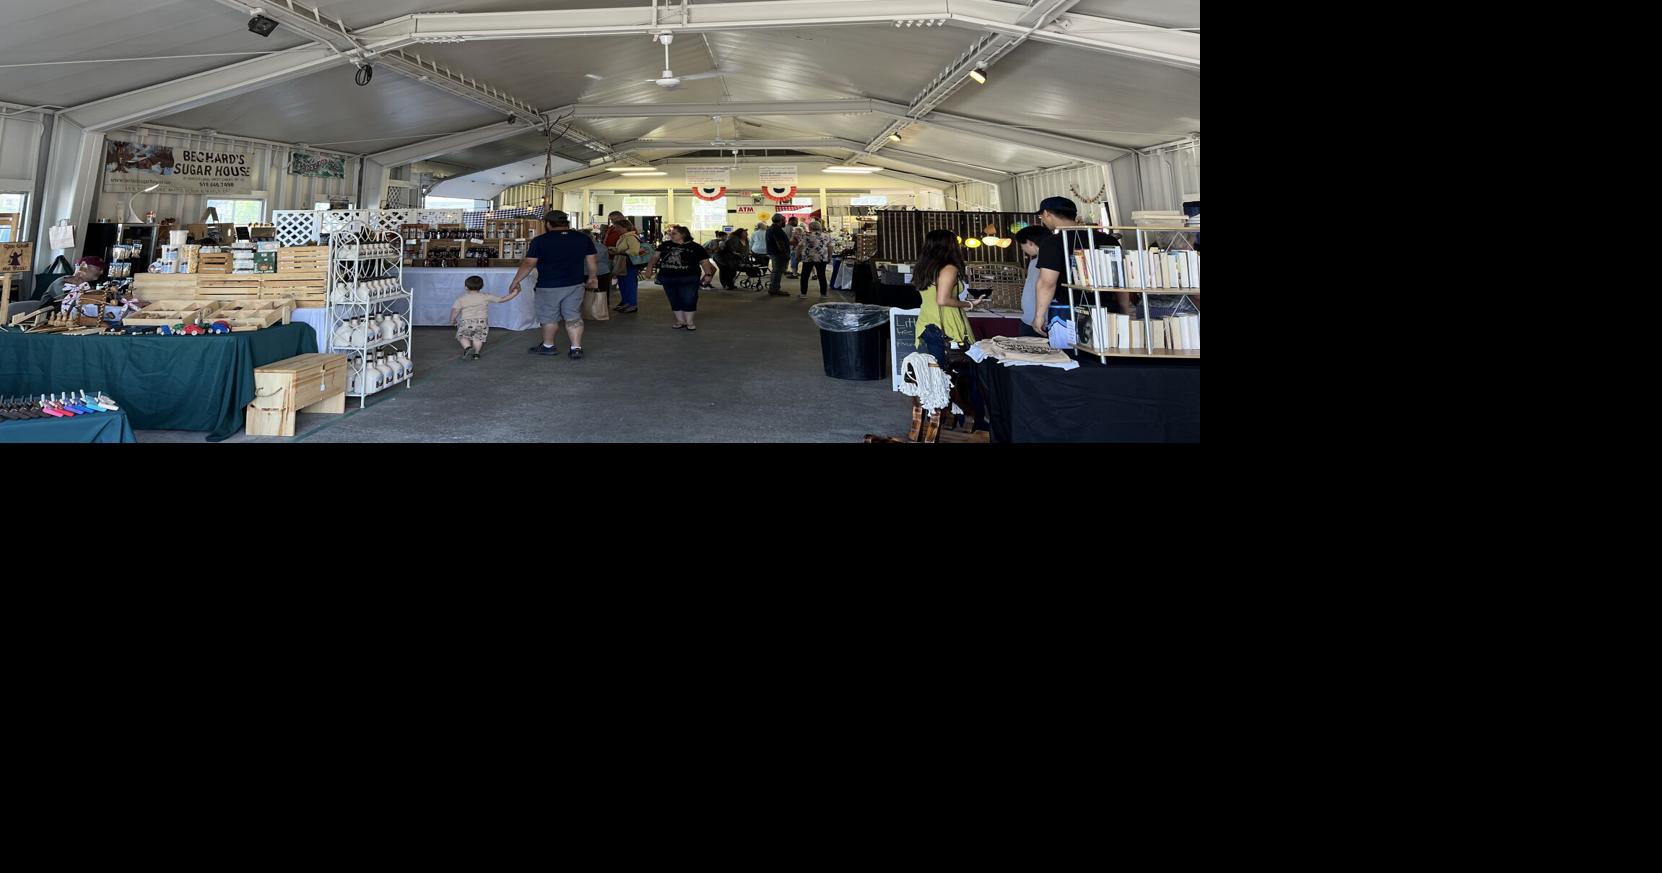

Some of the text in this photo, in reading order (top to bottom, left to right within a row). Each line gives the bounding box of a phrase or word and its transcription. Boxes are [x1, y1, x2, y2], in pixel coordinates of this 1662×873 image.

[183, 151, 245, 164] BECHARD'S
[174, 163, 250, 176] SUGAR HOUSE
